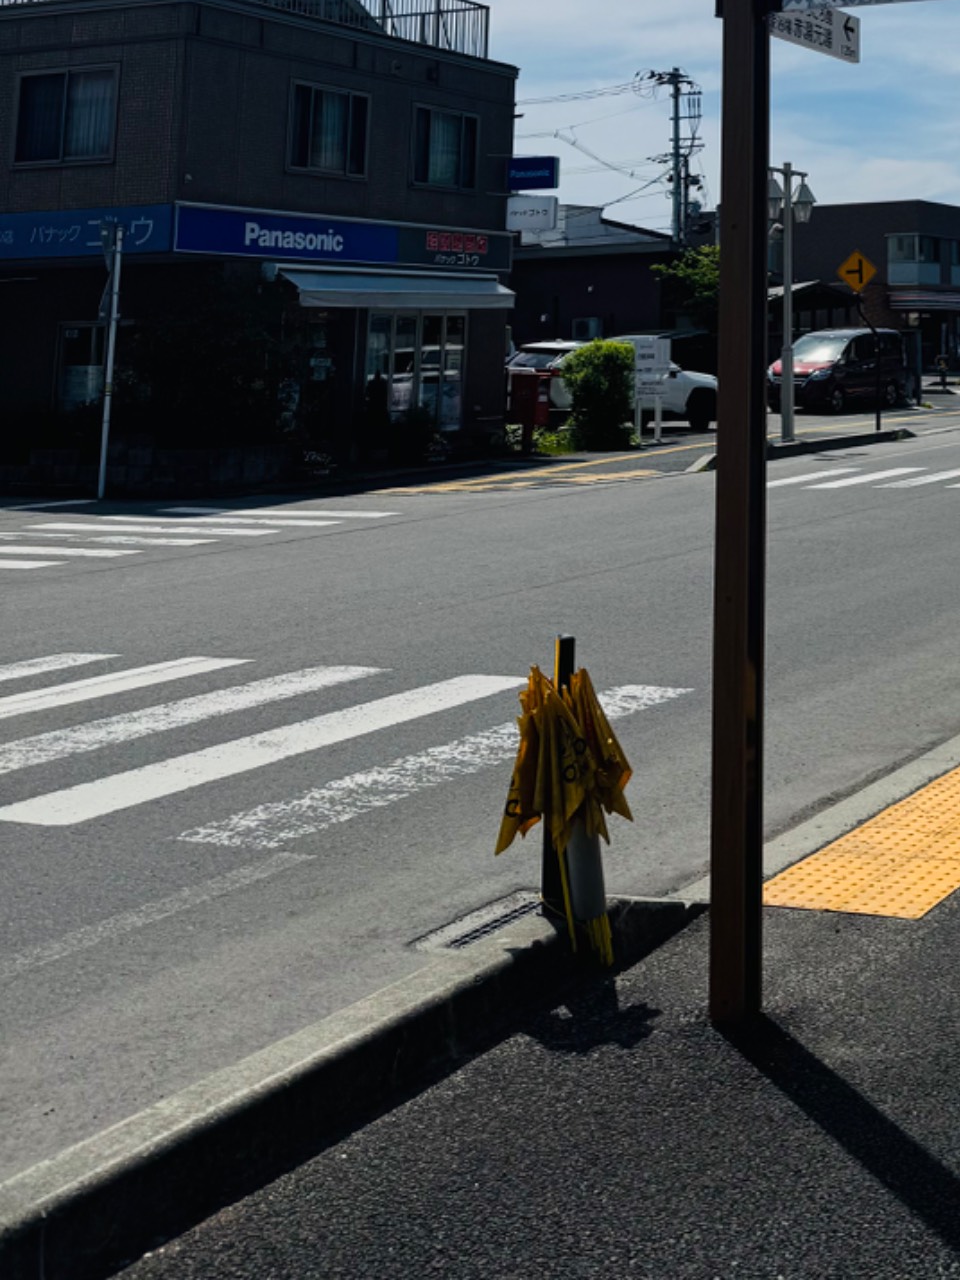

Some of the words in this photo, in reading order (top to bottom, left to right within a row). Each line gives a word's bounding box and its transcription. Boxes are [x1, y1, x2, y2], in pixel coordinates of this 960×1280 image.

[509, 169, 551, 178] Panasonic
[86, 215, 154, 247] ゴウ
[244, 222, 344, 252] Panasonic
